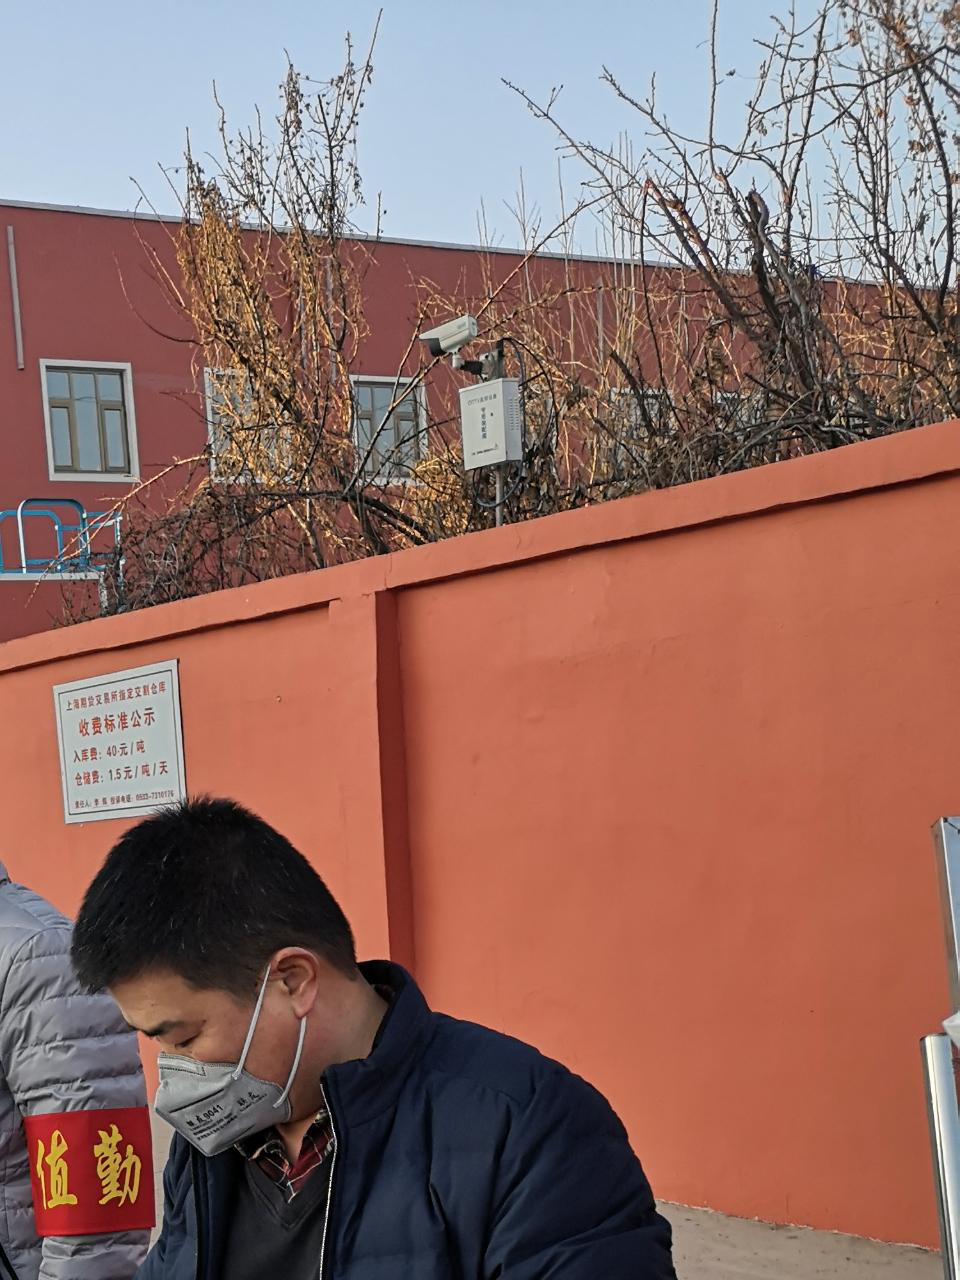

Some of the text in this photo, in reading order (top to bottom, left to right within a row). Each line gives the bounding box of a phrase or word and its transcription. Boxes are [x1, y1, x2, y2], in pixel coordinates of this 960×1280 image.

[78, 707, 156, 737] 收费标准公示
[202, 1104, 224, 1120] 9041
[36, 1123, 142, 1210] 值勤
